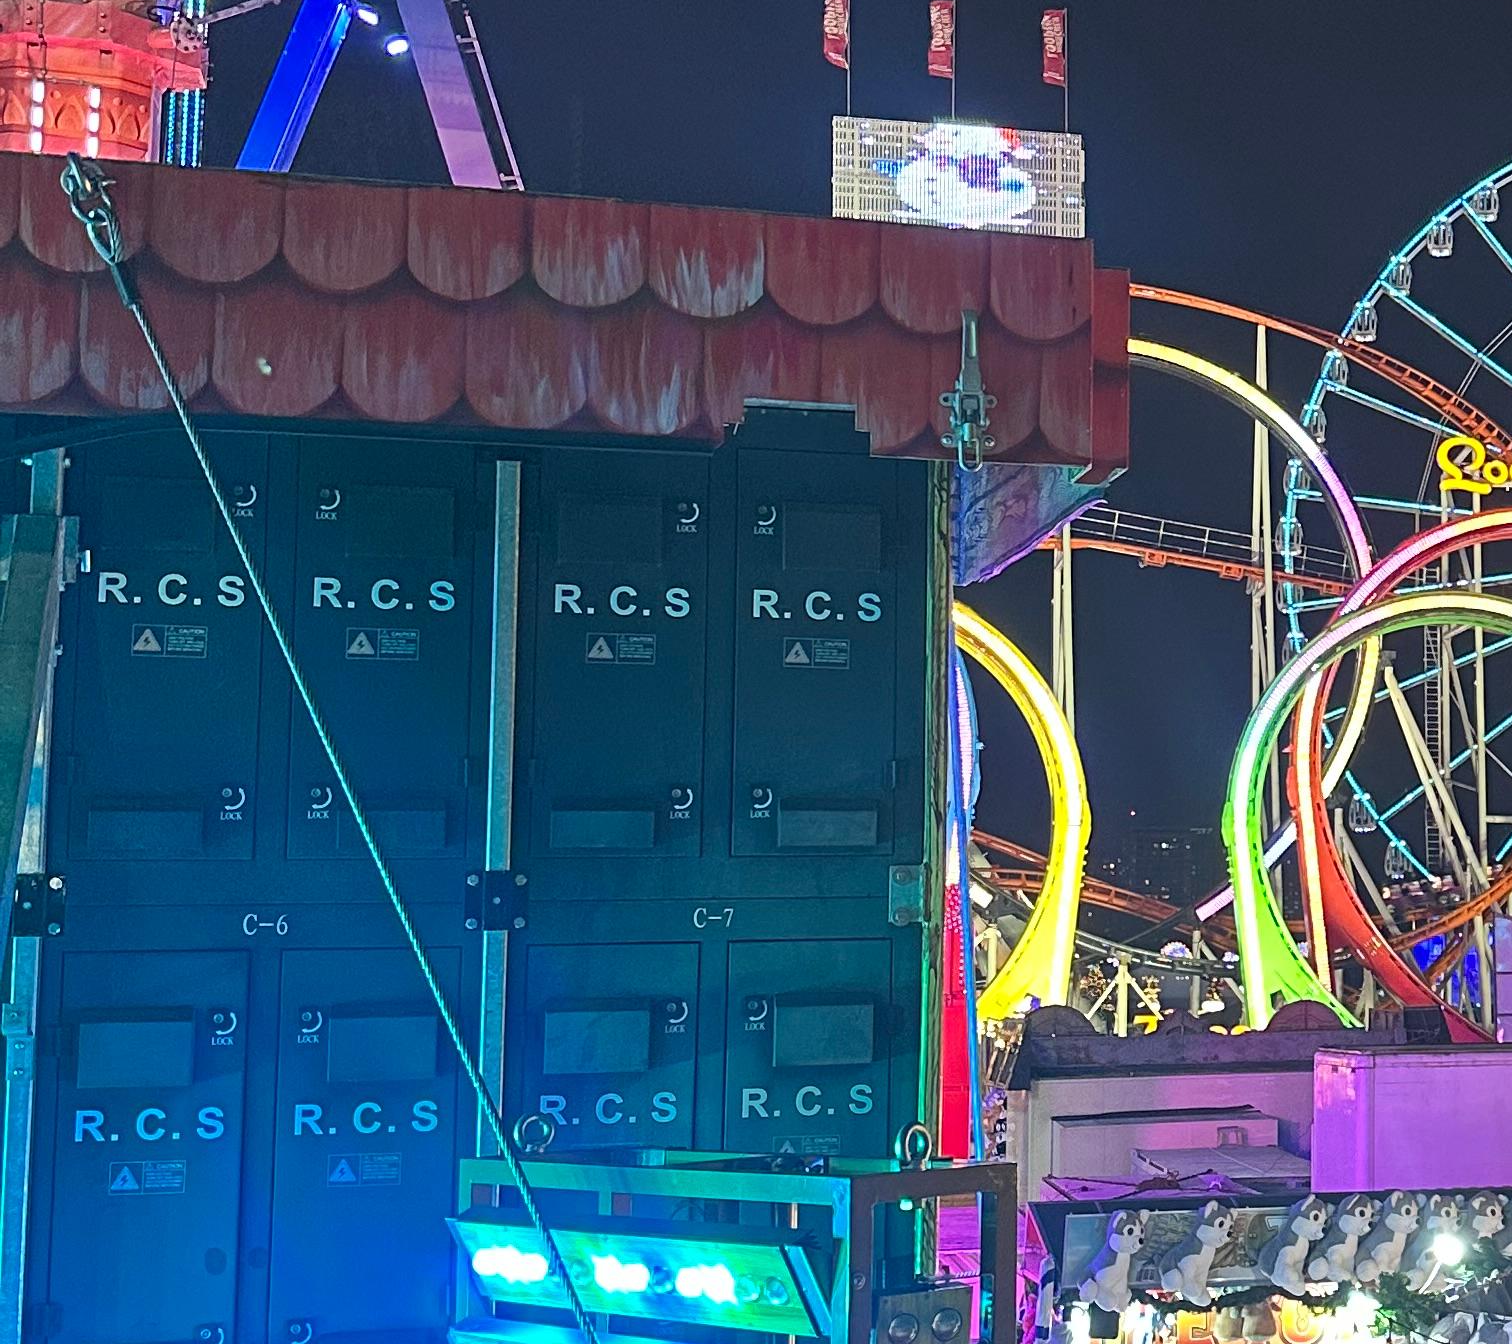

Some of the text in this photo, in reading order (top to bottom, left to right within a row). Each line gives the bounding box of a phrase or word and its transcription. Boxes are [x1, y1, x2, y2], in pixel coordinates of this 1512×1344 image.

[315, 511, 338, 521] LOCK
[676, 523, 697, 533] LOCK
[754, 524, 775, 535] LOCK
[220, 810, 243, 821] LOCK
[307, 809, 330, 820] LOCK
[670, 810, 690, 819] LOCK
[750, 809, 770, 819] LOCK
[693, 908, 735, 929] C-7
[242, 914, 289, 937] C-6
[664, 1024, 686, 1034] LOCK
[744, 1021, 766, 1031] LOCK
[211, 1035, 235, 1046] LOCK
[297, 1034, 320, 1045] LOCK
